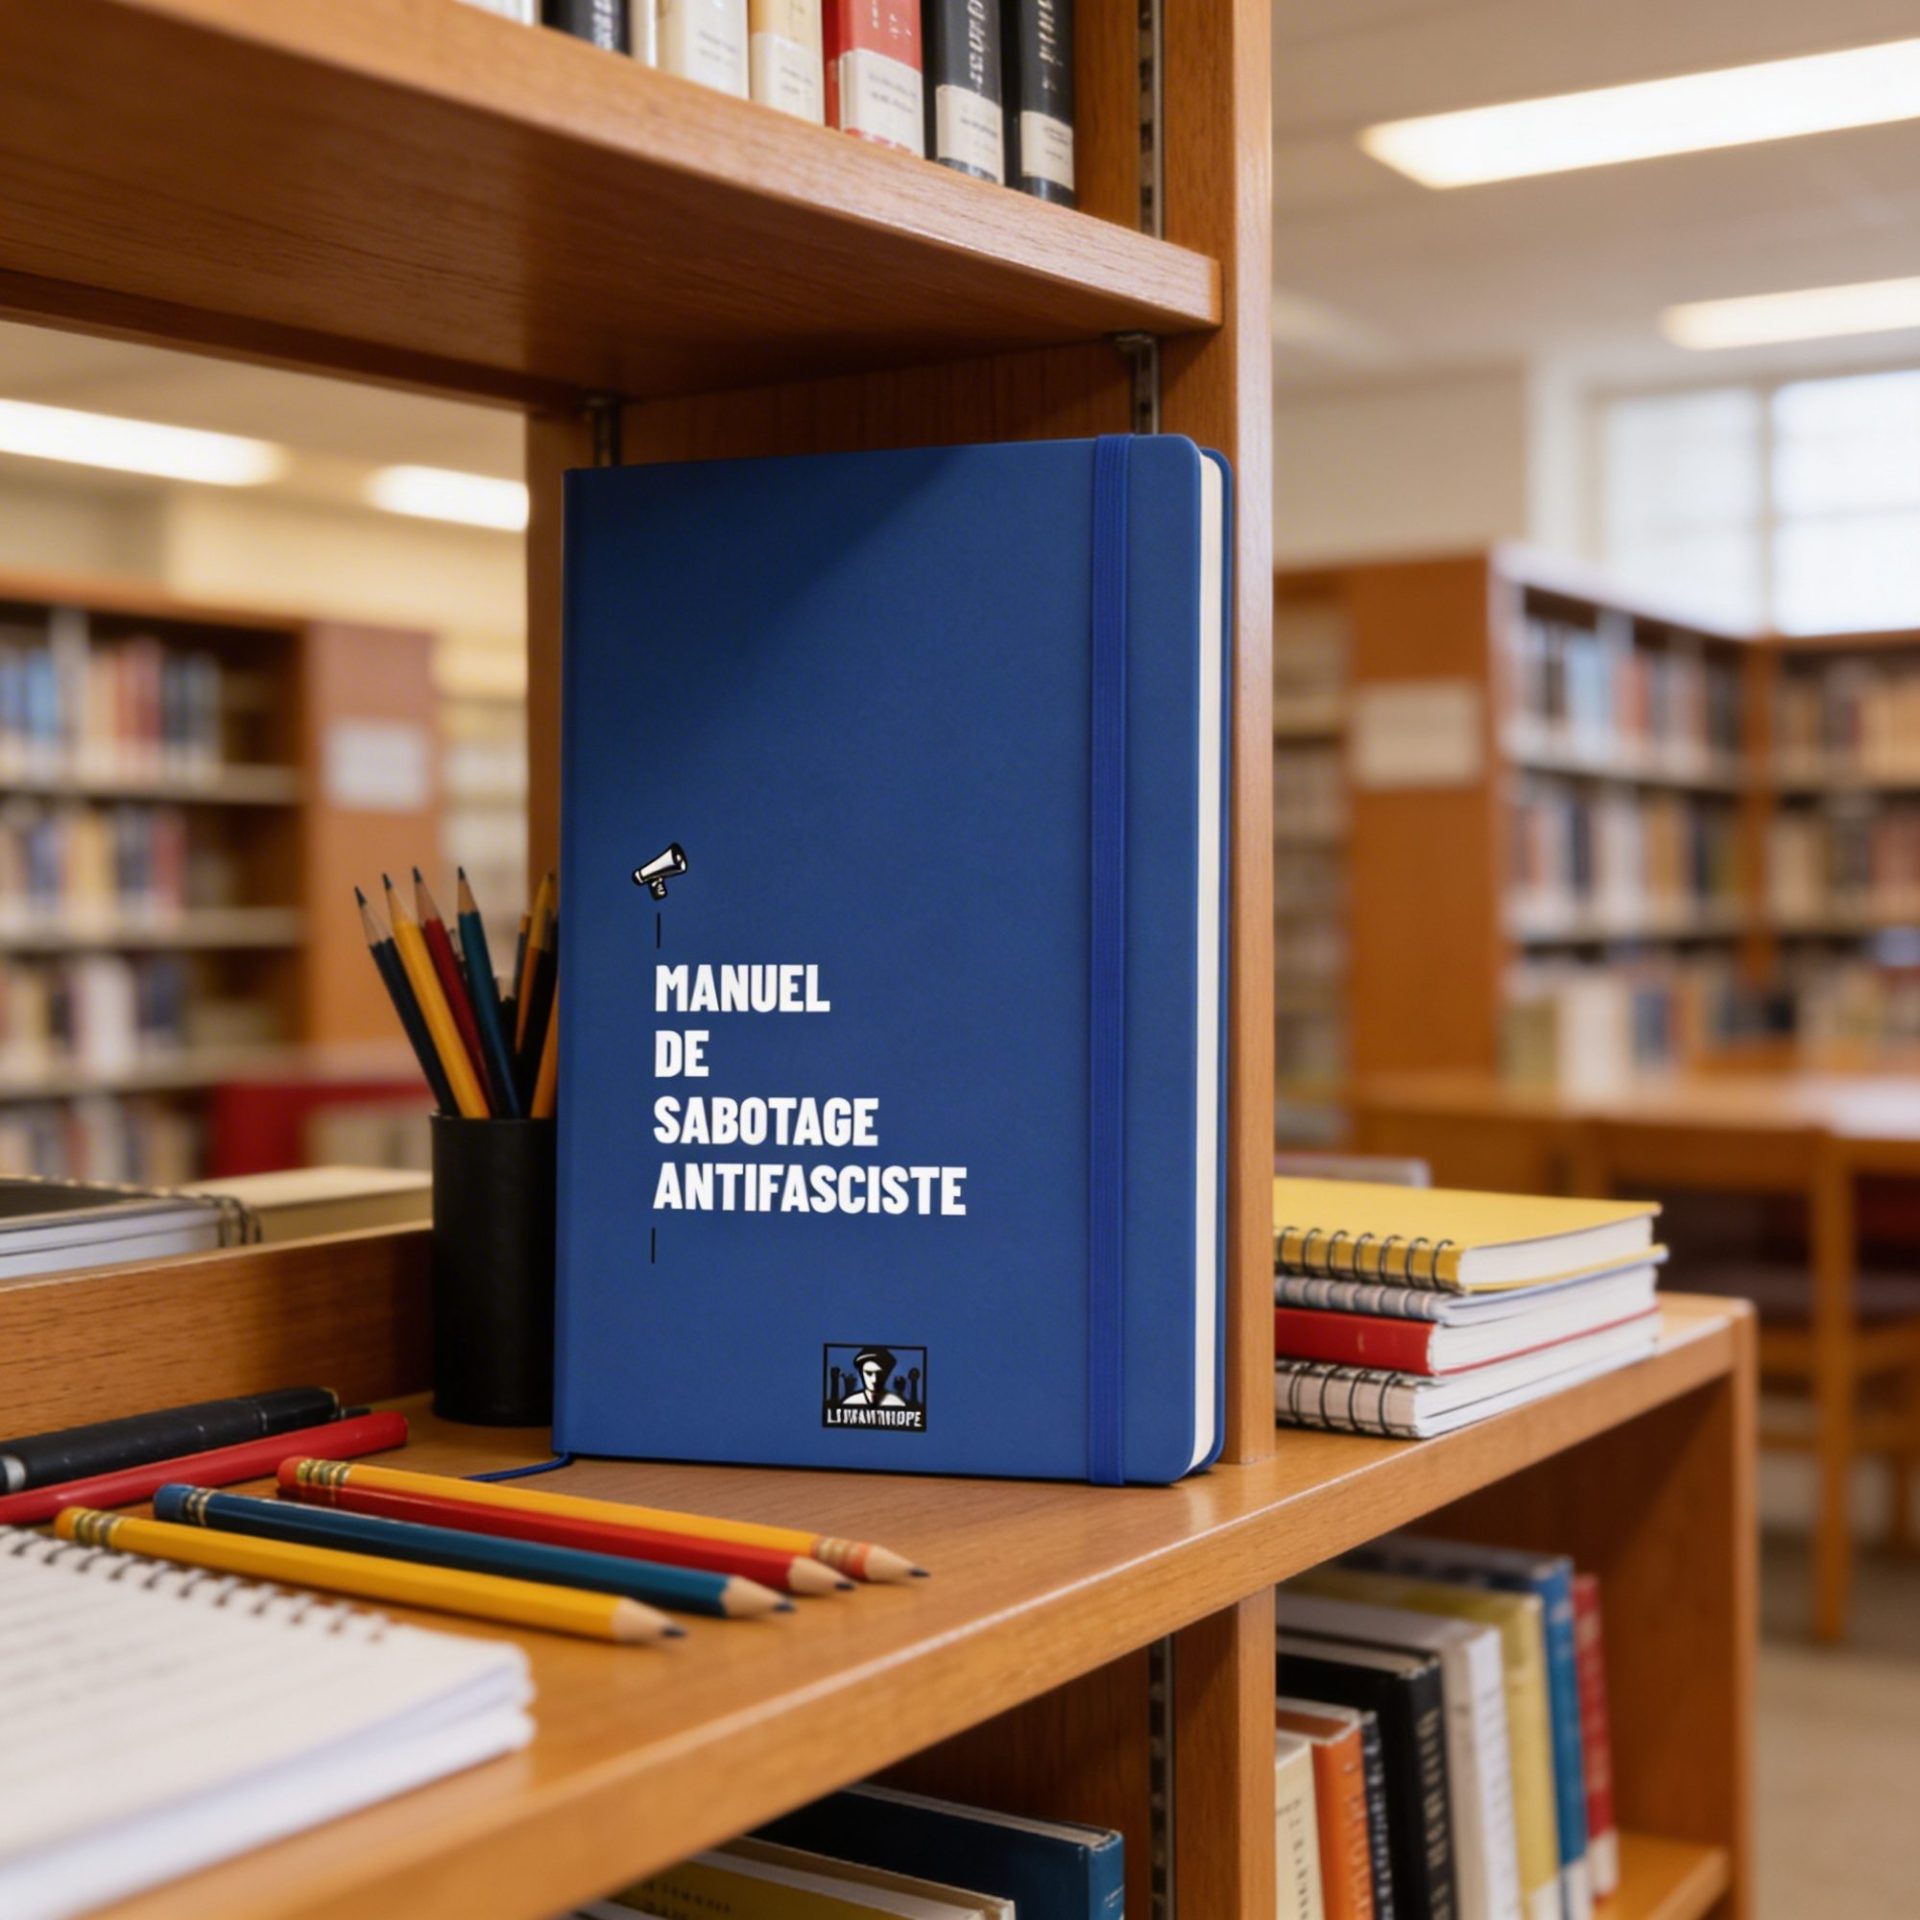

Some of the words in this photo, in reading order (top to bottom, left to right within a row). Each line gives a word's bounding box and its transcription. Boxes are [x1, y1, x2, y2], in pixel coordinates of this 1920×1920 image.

[655, 964, 831, 1012] MANUEL
[655, 1029, 710, 1078] DE
[653, 1095, 879, 1147] SABOTAGE
[653, 1162, 967, 1216] ANTIFASCISTE
